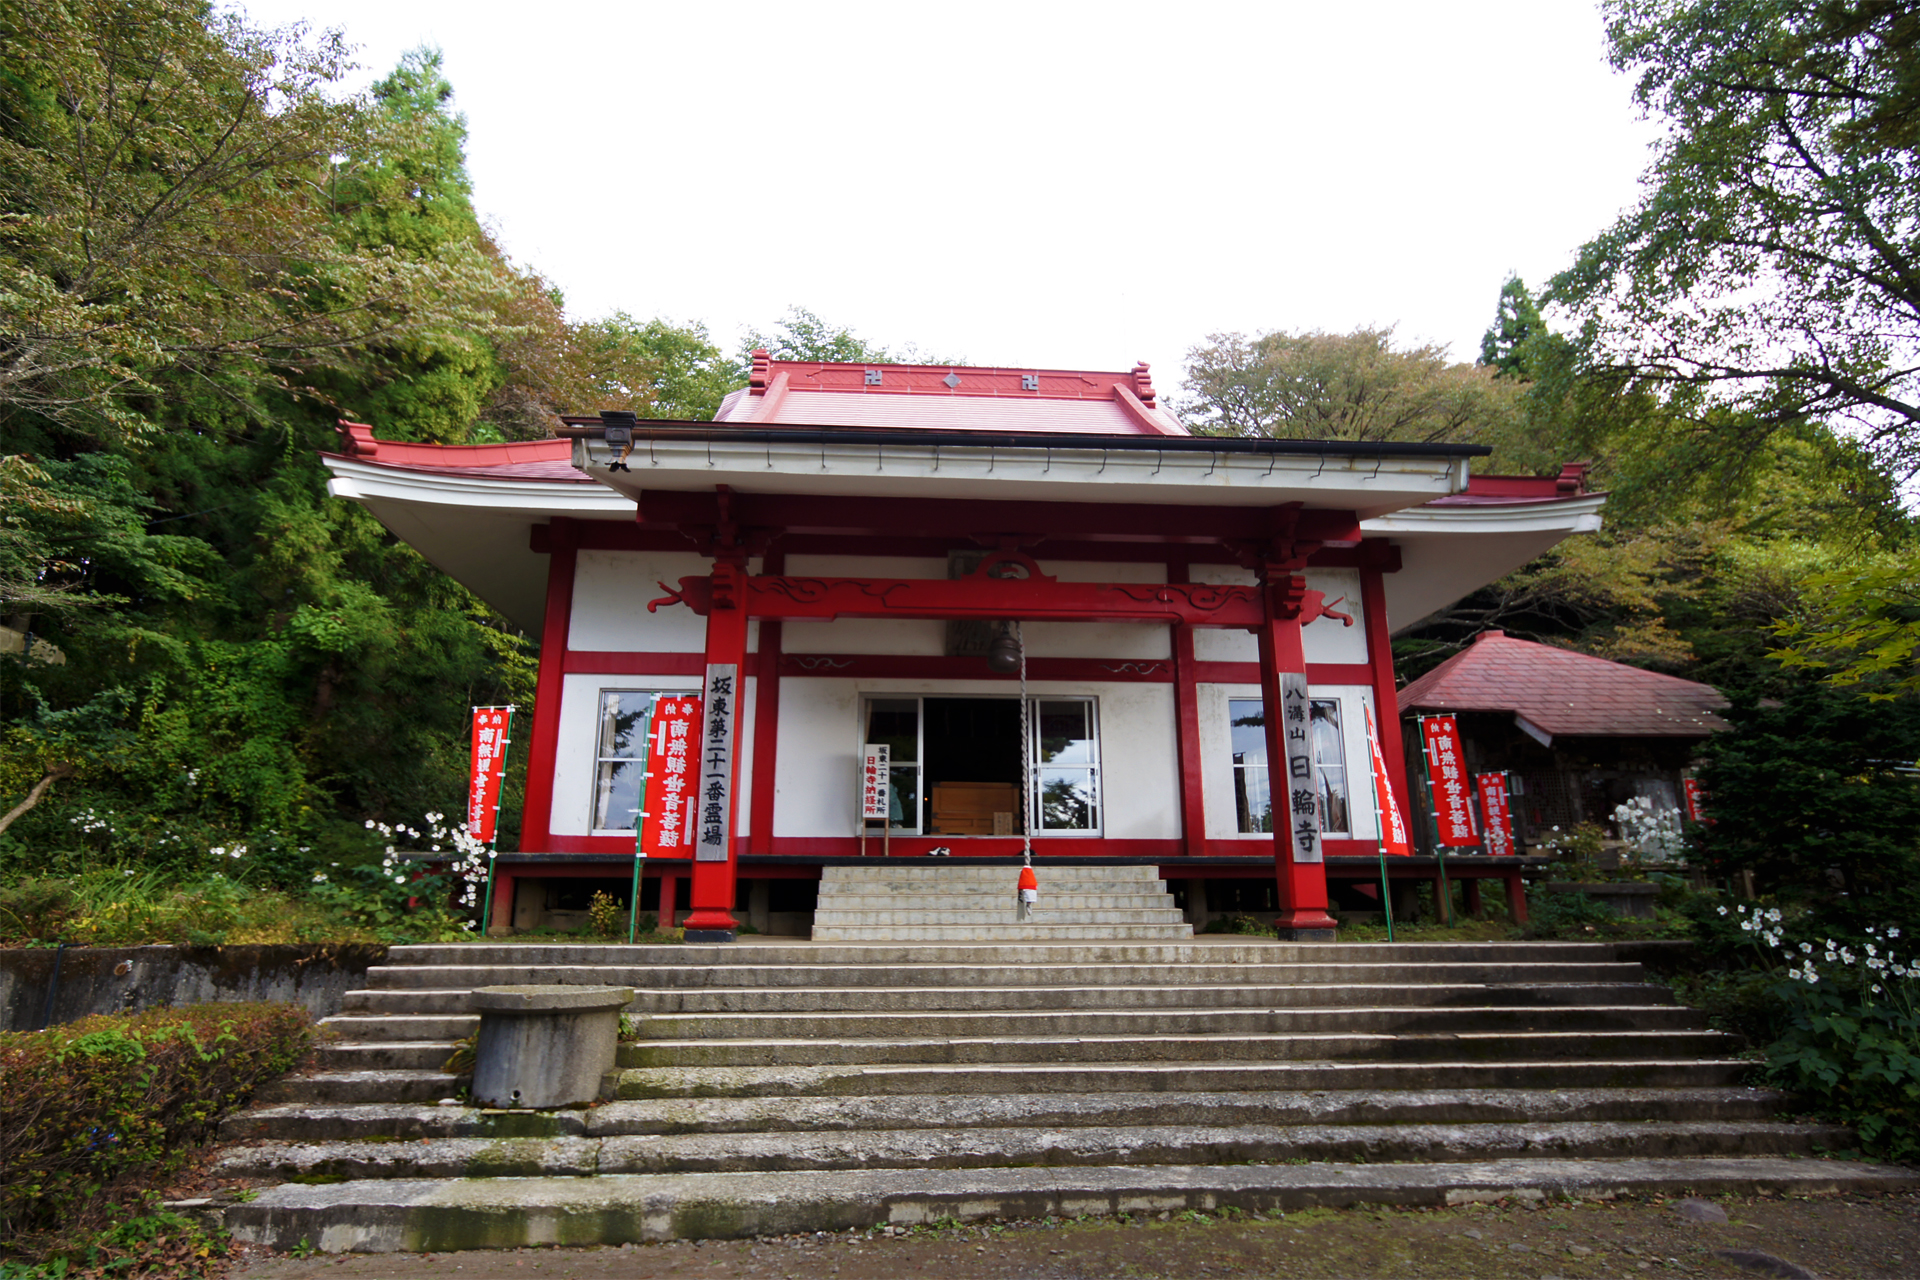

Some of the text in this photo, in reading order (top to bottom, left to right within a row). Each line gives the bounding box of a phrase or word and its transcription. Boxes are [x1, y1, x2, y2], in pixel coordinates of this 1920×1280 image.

[701, 676, 733, 847] 坂東第二十一番霊場
